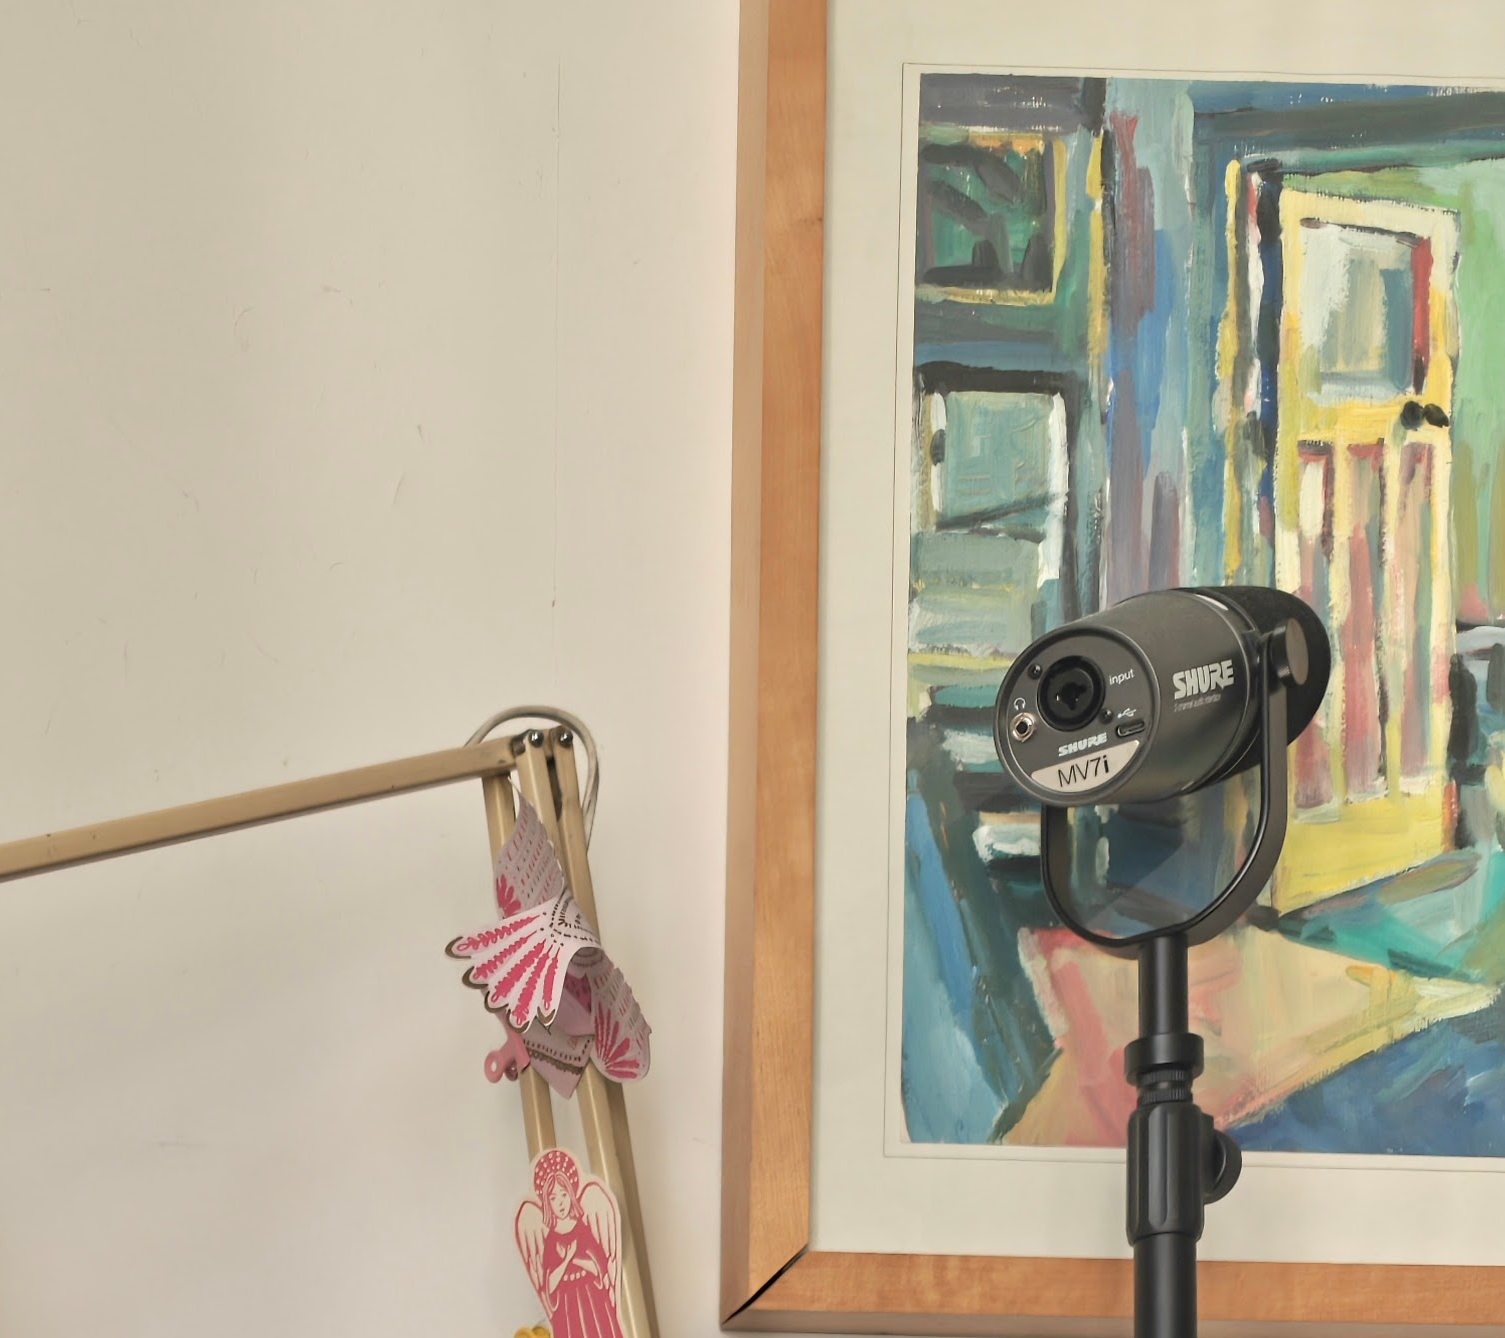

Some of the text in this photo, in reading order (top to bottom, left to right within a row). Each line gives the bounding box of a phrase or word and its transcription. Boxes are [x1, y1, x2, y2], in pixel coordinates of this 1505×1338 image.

[1109, 669, 1134, 685] input
[1173, 659, 1234, 699] SHURE
[1058, 732, 1107, 757] SHURE
[1058, 755, 1109, 787] MV7i
